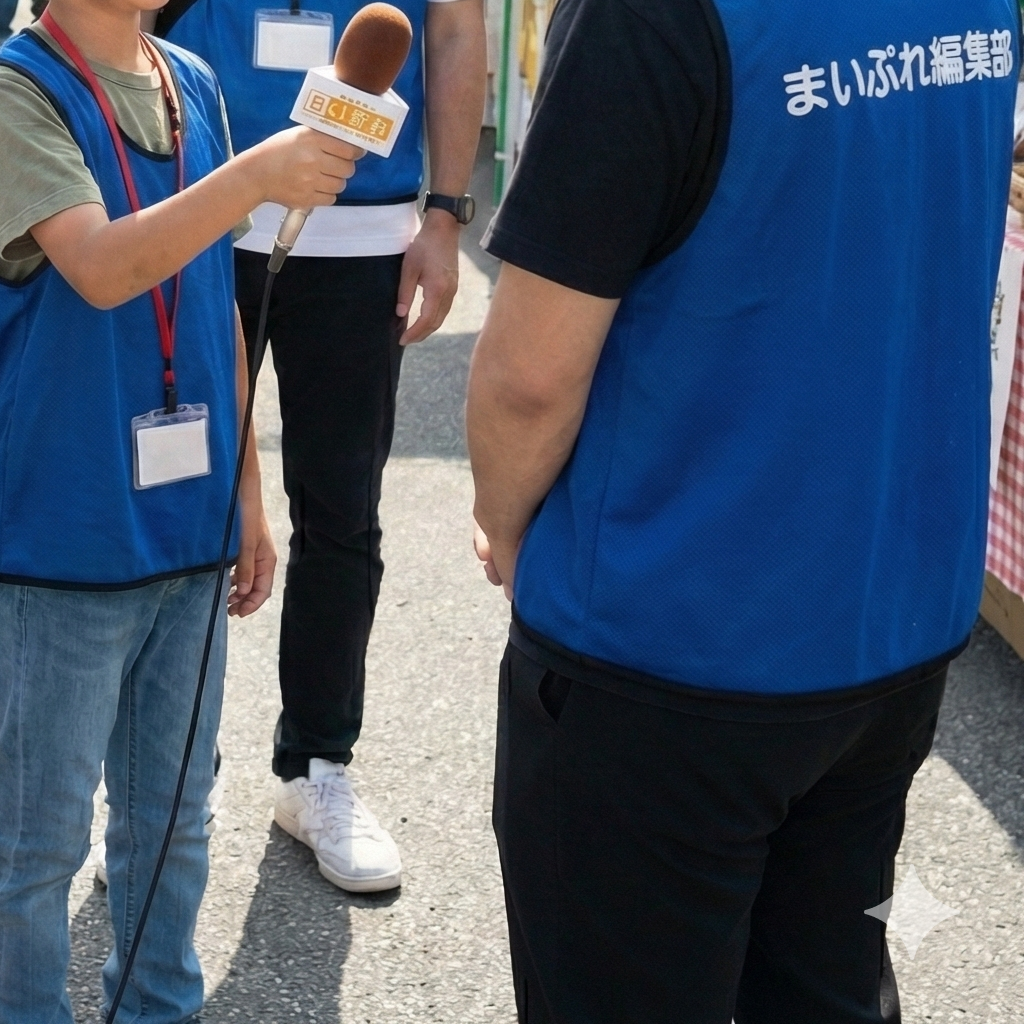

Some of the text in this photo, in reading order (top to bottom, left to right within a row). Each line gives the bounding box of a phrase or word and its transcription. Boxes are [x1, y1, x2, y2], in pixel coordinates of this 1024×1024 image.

[783, 29, 1013, 116] まいぷれ編集部
